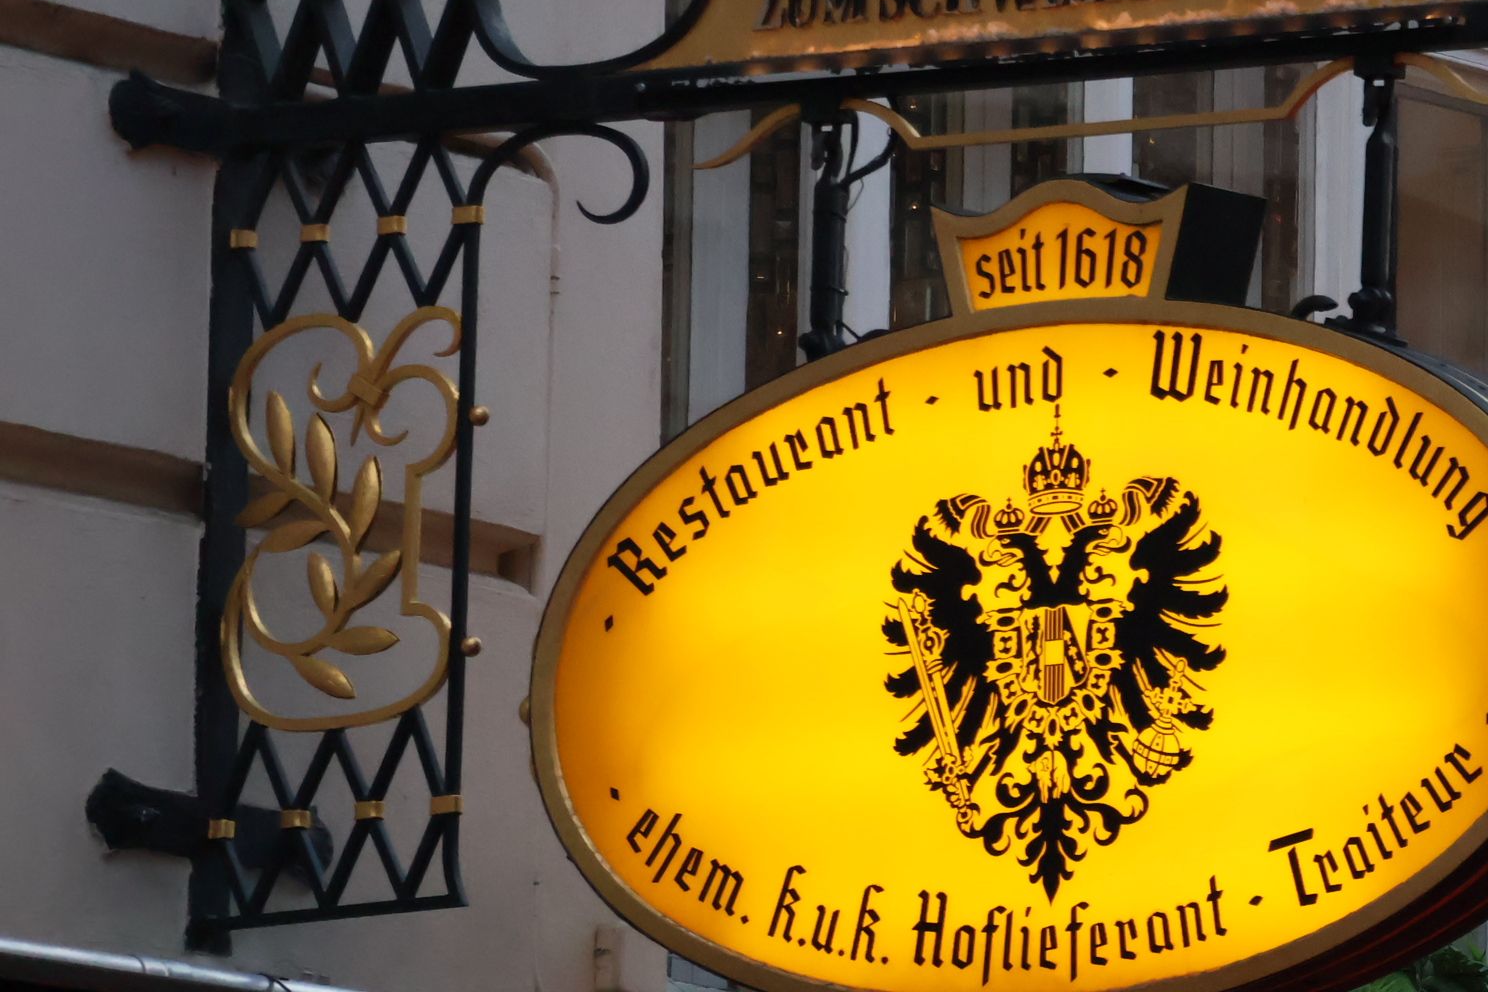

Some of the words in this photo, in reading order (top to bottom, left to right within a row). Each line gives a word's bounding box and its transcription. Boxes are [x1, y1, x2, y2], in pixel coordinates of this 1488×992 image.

[975, 228, 1047, 299] seit
[1056, 226, 1149, 291] 1618
[607, 376, 896, 597] Restaurant
[973, 345, 1064, 413] und
[625, 808, 750, 925] ehem.
[911, 874, 1228, 987] Hoflieferant
[1267, 742, 1484, 907] Traiteur
